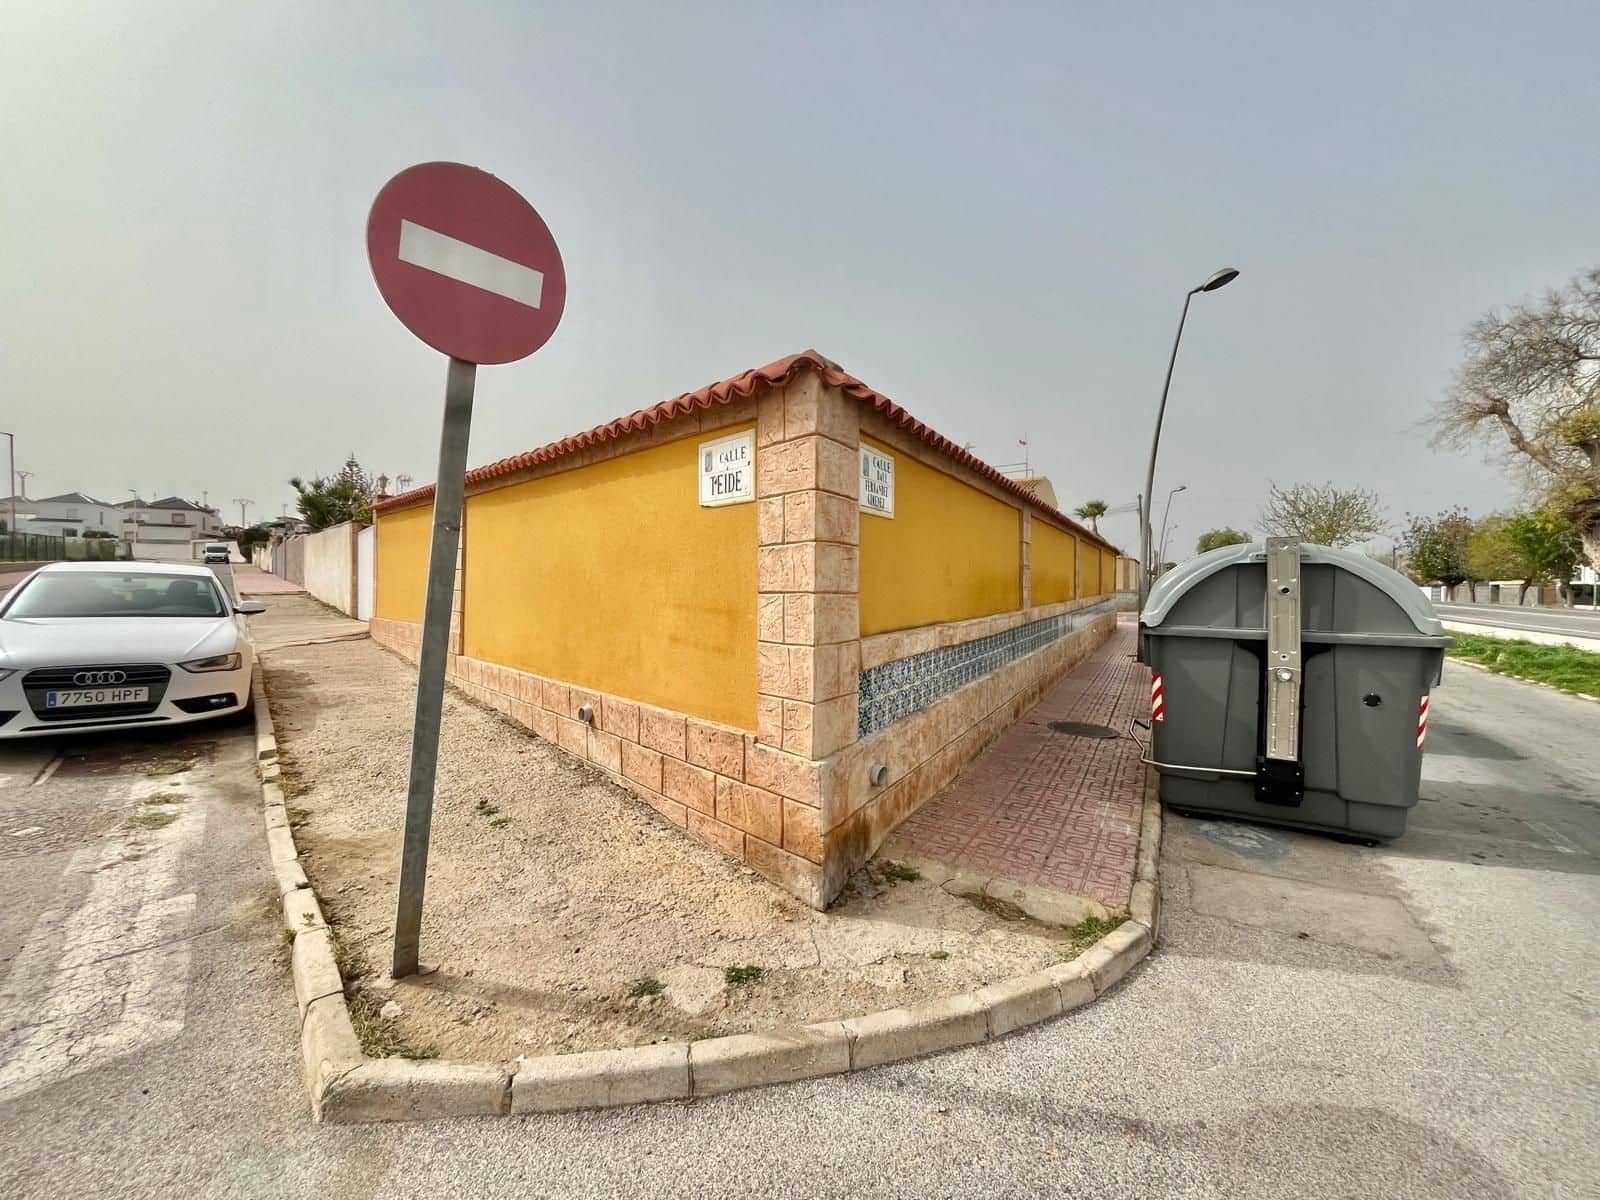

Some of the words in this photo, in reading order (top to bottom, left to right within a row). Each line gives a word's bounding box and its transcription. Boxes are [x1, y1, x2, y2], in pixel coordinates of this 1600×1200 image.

[720, 446, 747, 463] CALLE
[873, 456, 891, 473] CALLE
[710, 470, 742, 496] TEIDE
[61, 691, 105, 705] 7750
[112, 688, 144, 702] HPF
